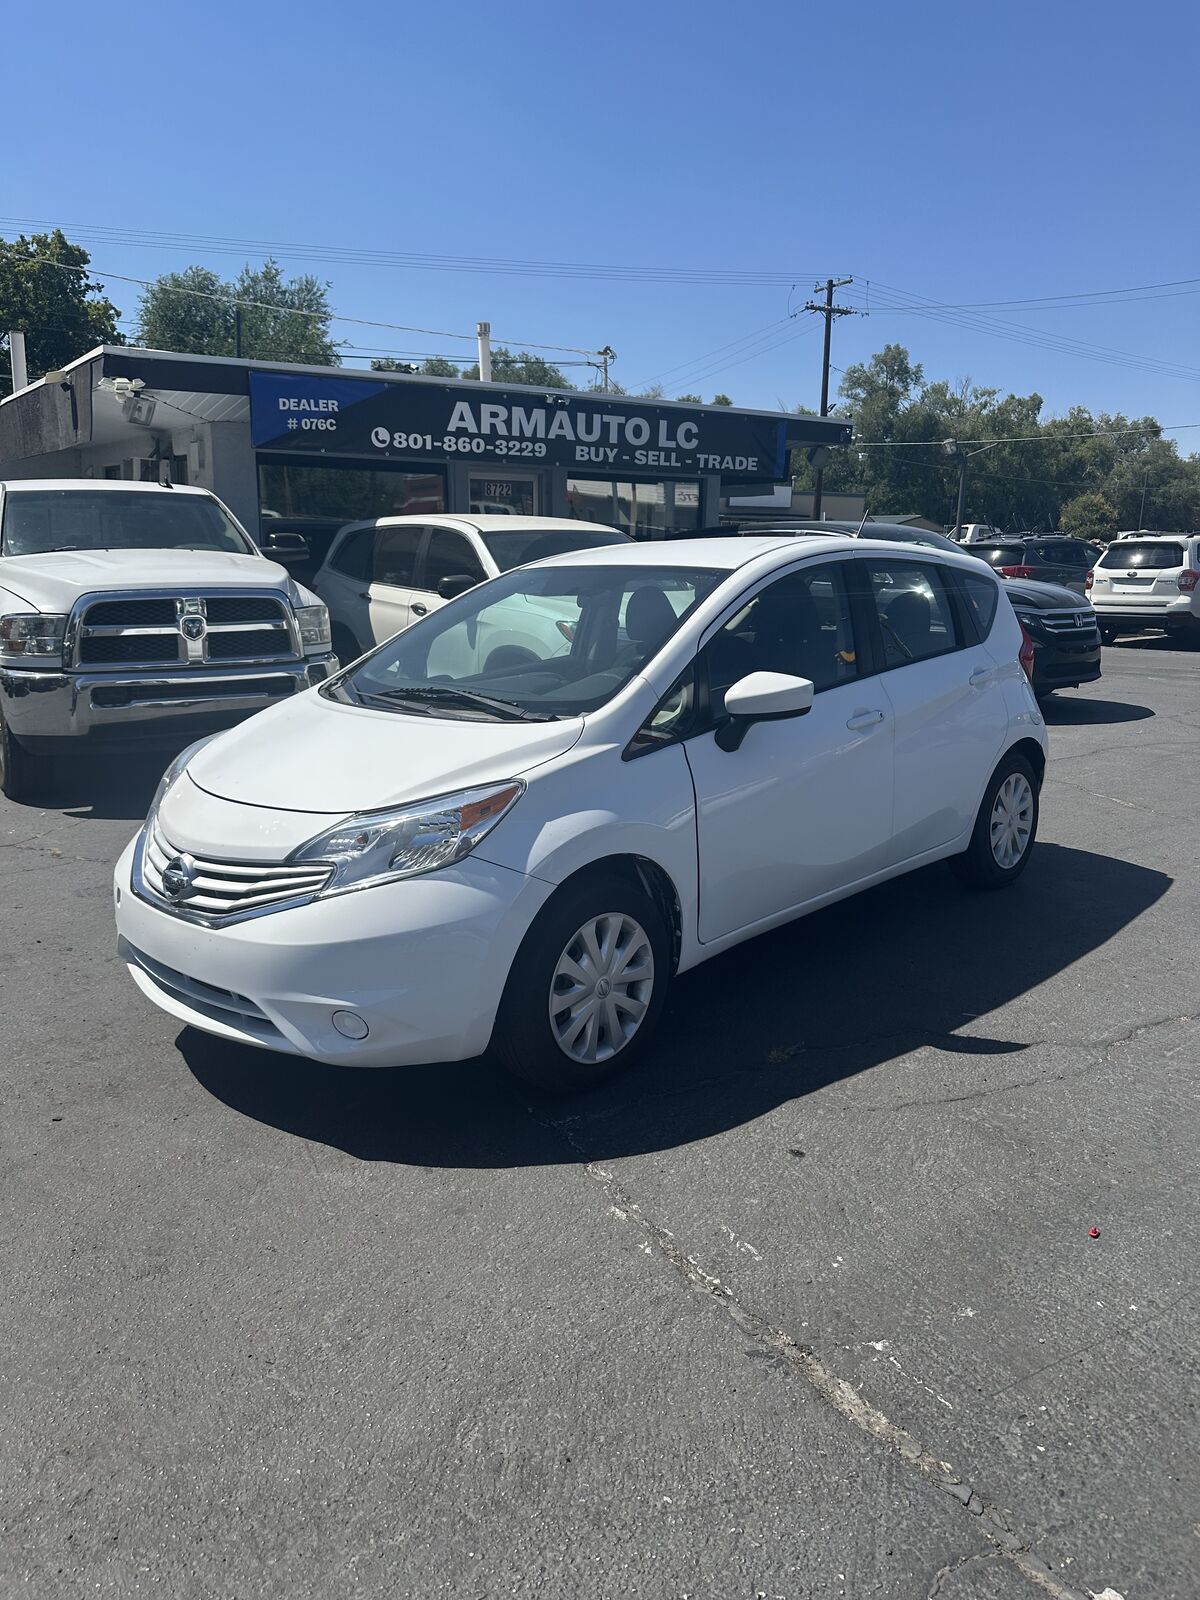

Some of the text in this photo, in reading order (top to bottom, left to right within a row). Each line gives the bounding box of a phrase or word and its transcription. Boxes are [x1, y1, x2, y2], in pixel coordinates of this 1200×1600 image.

[278, 398, 339, 412] DEALER
[301, 418, 337, 431] 076C
[447, 401, 699, 450] ARMAUTO LC
[392, 432, 547, 458] 801-860-3229
[575, 445, 618, 463] BUY
[634, 450, 681, 467] SELL
[697, 453, 758, 471] TRADE
[486, 483, 511, 496] 8722
